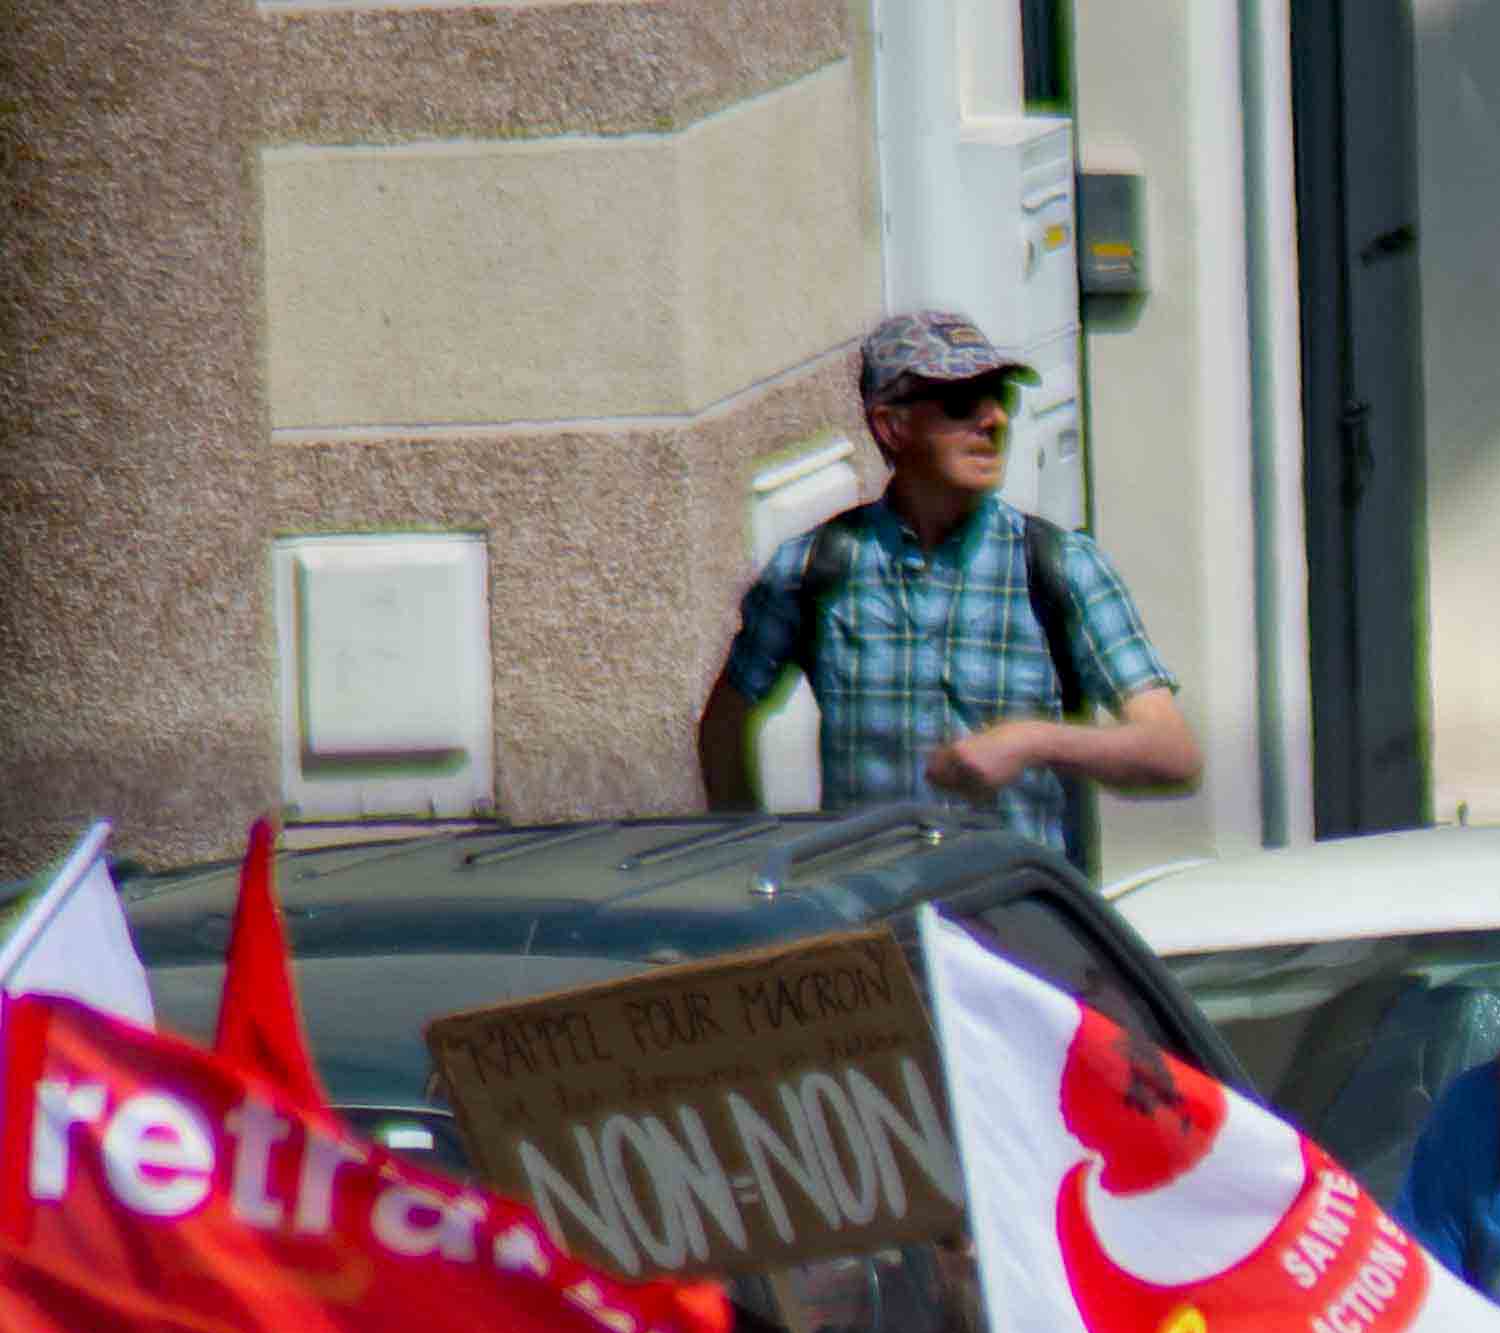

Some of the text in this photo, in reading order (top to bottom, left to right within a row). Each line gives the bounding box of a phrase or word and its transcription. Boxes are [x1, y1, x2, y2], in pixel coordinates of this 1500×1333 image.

[466, 1008, 614, 1086] RAPPEL
[622, 991, 726, 1058] POUR
[736, 938, 895, 1036] MACRON
